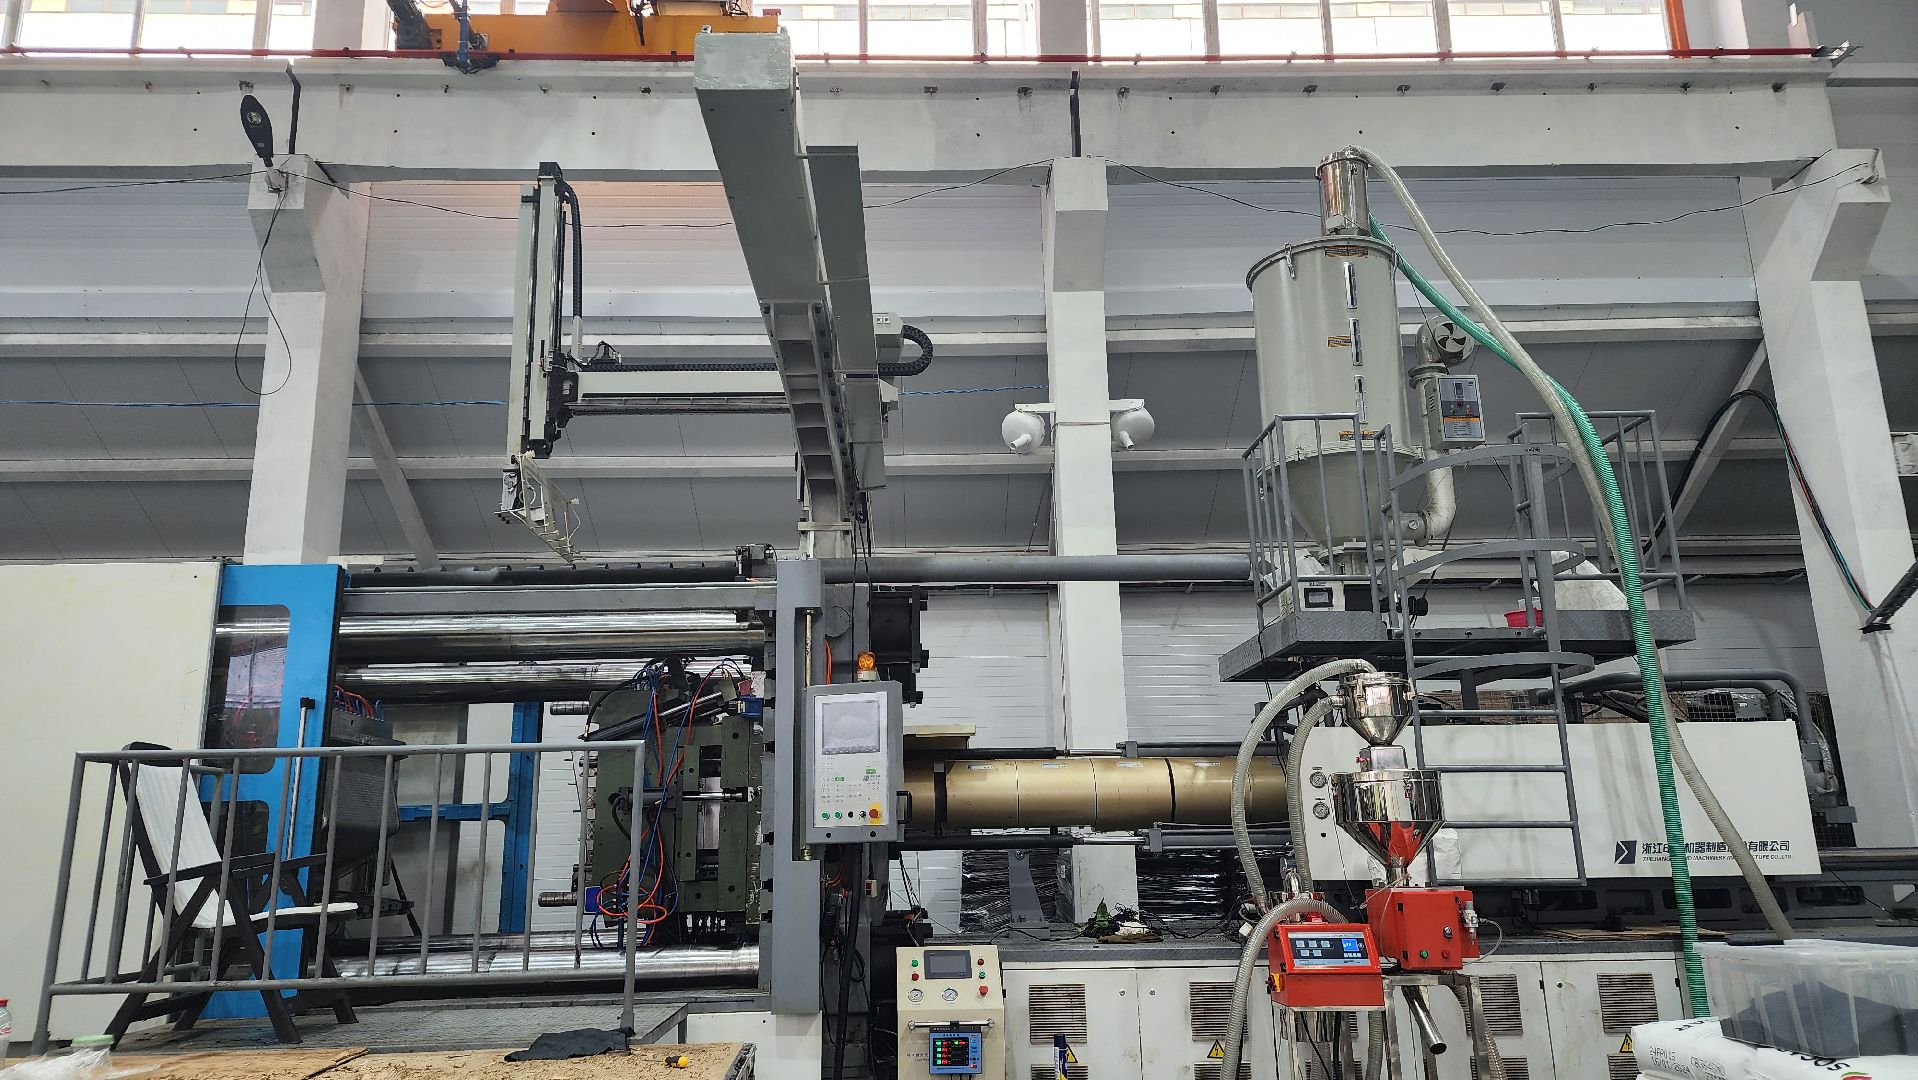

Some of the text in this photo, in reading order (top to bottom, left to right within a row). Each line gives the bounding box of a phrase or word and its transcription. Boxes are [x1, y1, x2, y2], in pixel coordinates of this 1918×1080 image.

[1642, 840, 1790, 854] 浙江机器制造有限公司
